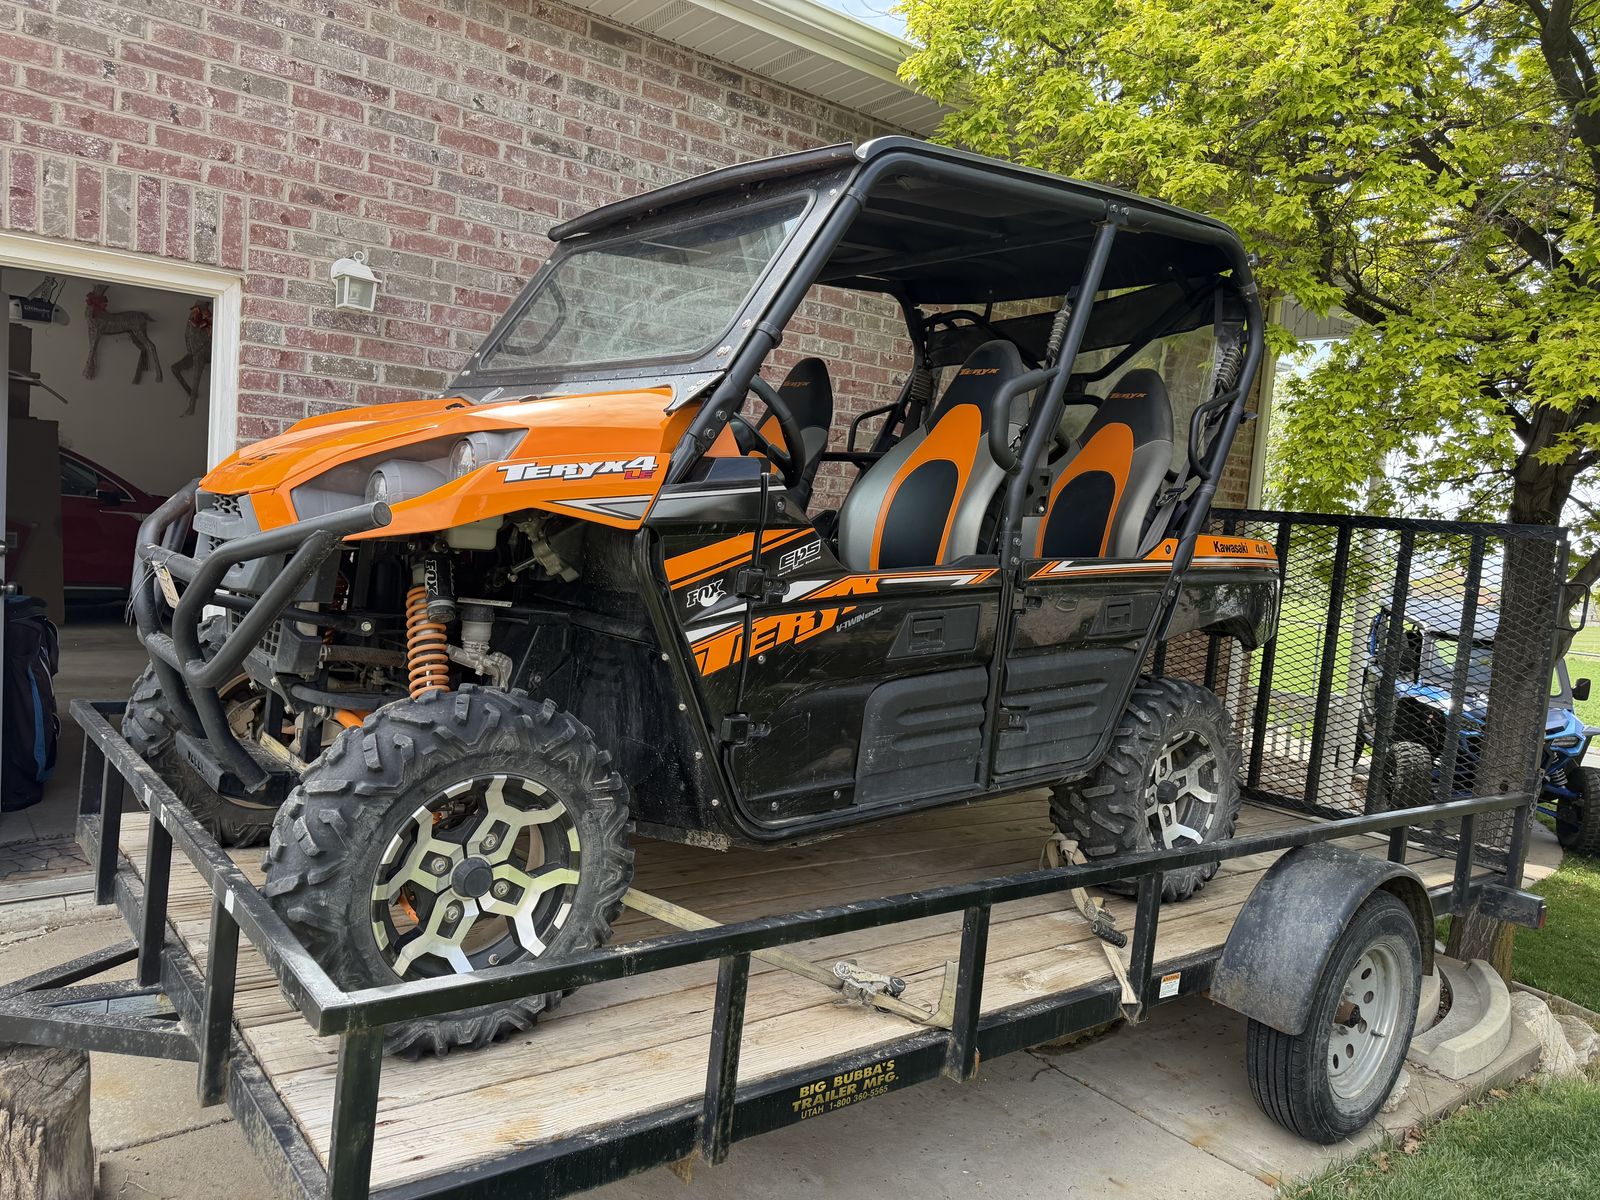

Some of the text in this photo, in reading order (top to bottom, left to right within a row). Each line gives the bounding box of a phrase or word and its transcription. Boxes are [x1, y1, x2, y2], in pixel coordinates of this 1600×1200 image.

[624, 469, 656, 480] LE
[779, 539, 821, 570] EPS
[1213, 540, 1249, 554] Kawasaki
[425, 560, 439, 597] FOX
[686, 578, 727, 608] FOX
[792, 1071, 900, 1113] TRAILER MFG.
[800, 1060, 895, 1099] BIG BUBBA'S
[801, 1105, 824, 1120] UTAH
